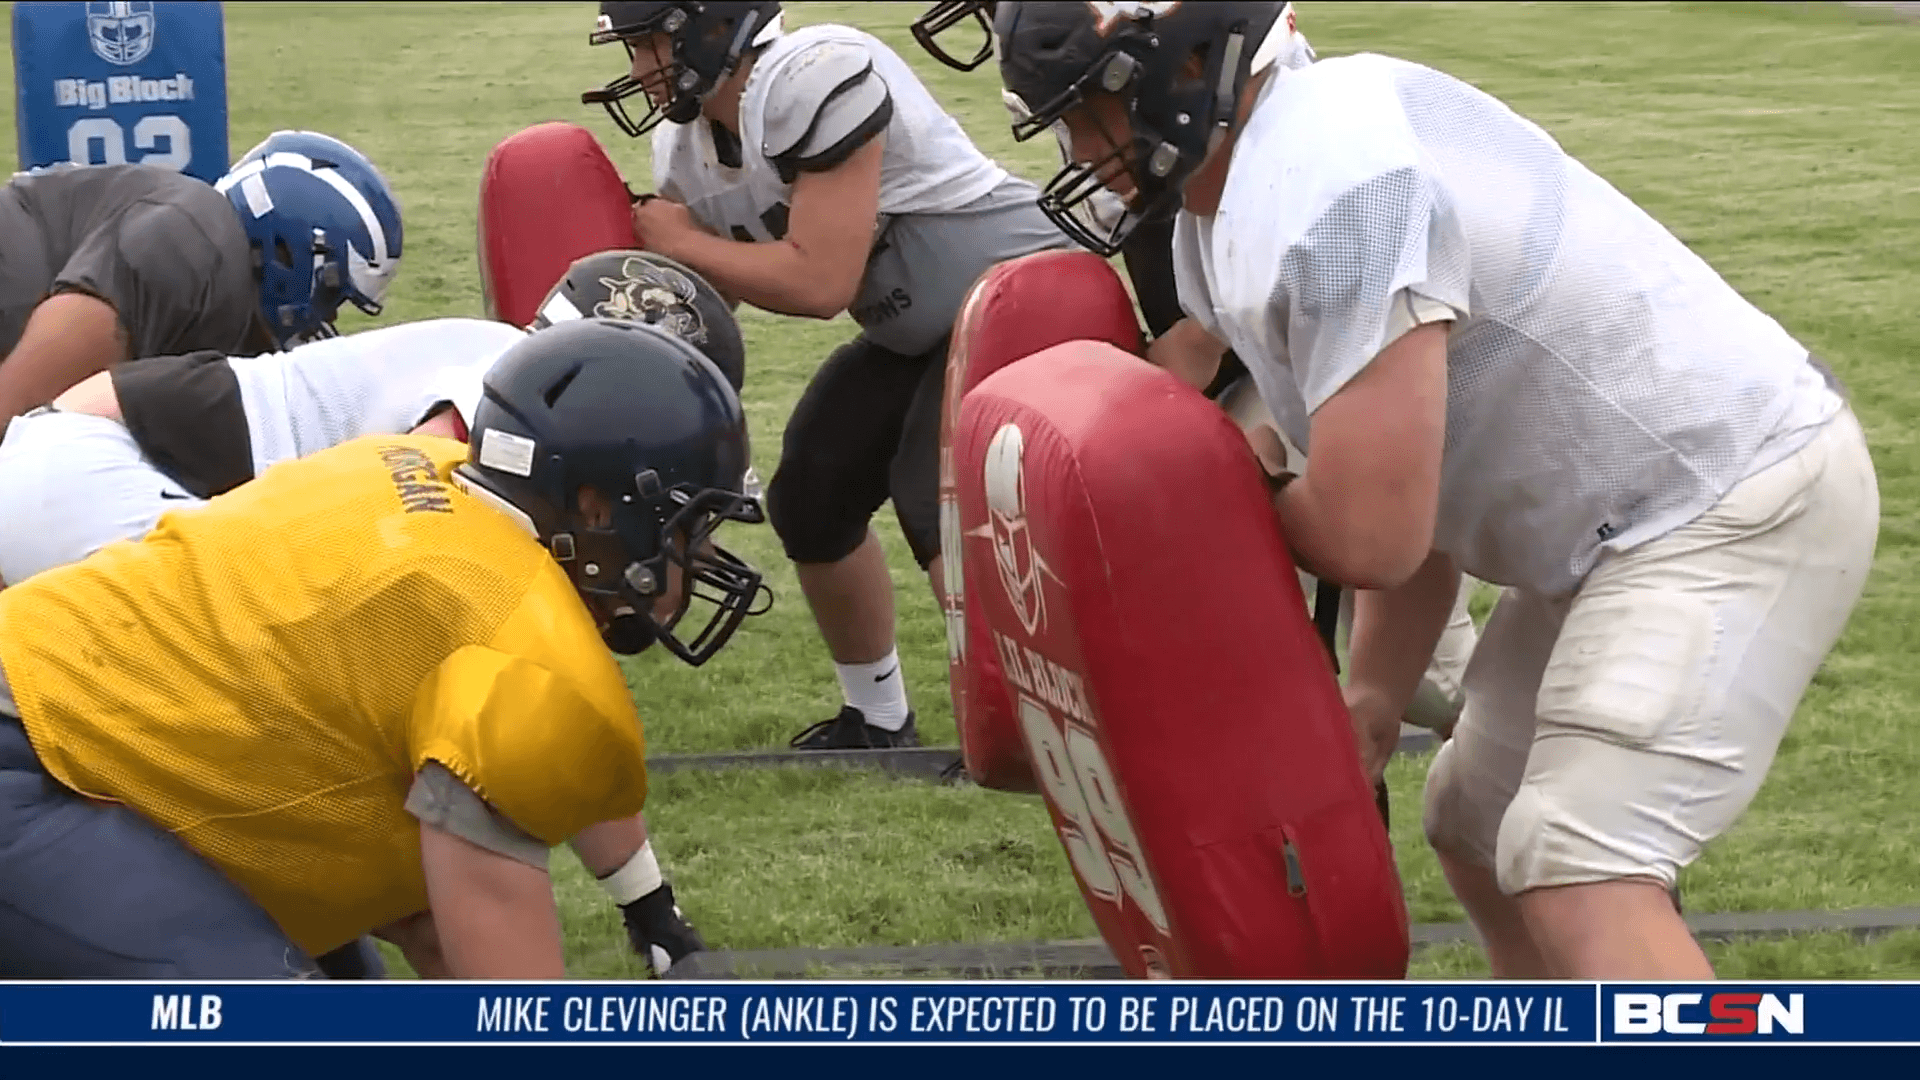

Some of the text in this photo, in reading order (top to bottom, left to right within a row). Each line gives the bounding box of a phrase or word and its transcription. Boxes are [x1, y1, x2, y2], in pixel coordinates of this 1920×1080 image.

[54, 73, 195, 110] Big Block
[992, 629, 1098, 728] LIL BLOCK
[1017, 691, 1172, 938] 99
